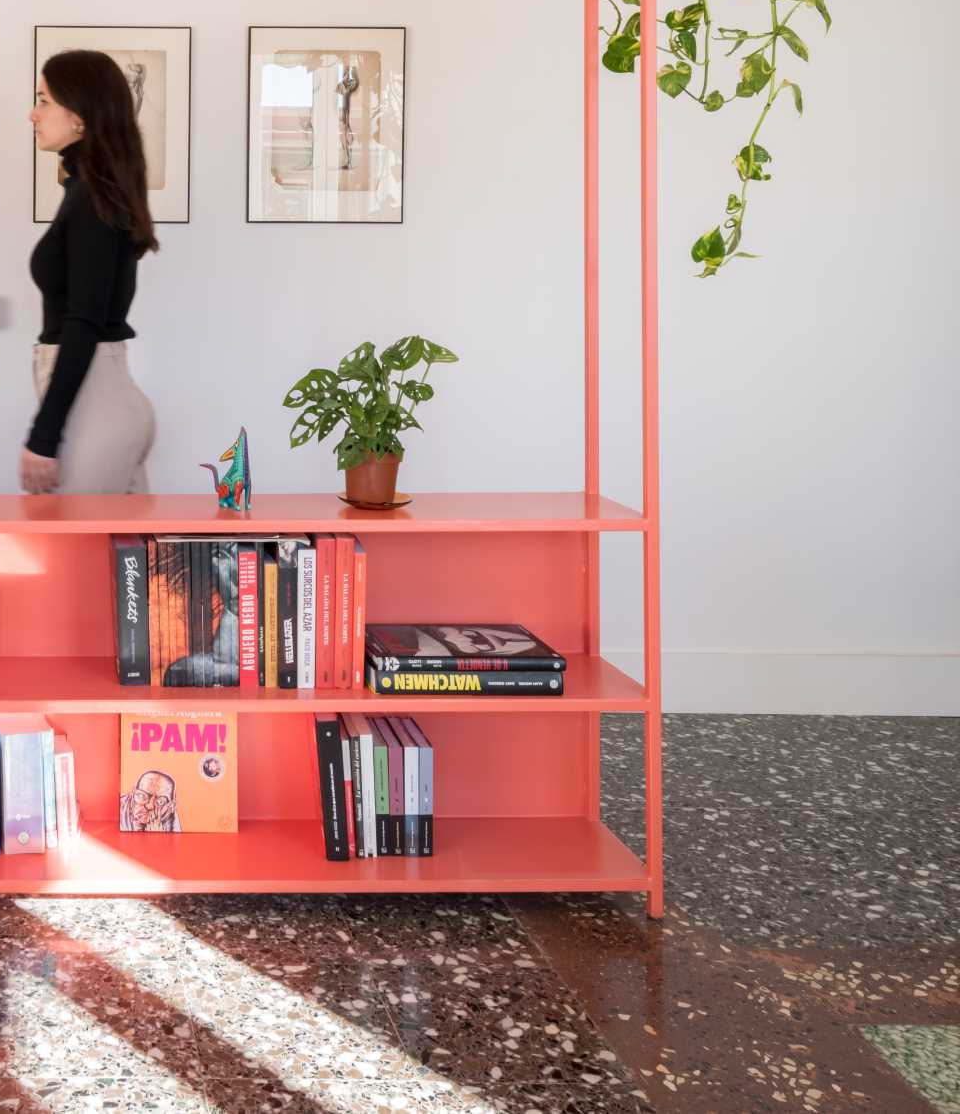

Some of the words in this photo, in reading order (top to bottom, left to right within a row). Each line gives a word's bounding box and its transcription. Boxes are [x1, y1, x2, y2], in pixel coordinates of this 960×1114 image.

[247, 560, 255, 583] BURNS
[304, 557, 313, 569] LOS
[304, 570, 313, 597] SURCOS
[323, 575, 329, 583] LA
[342, 573, 349, 582] LA
[124, 556, 140, 624] Blankets
[242, 594, 255, 624] NEGRO
[304, 598, 313, 610] DEL
[303, 612, 312, 632] AZAR
[242, 629, 255, 670] AGUJERO
[283, 617, 295, 664] HELLBLAZER
[394, 673, 481, 691] WATCHMEN
[131, 723, 227, 753] ¡PAM!
